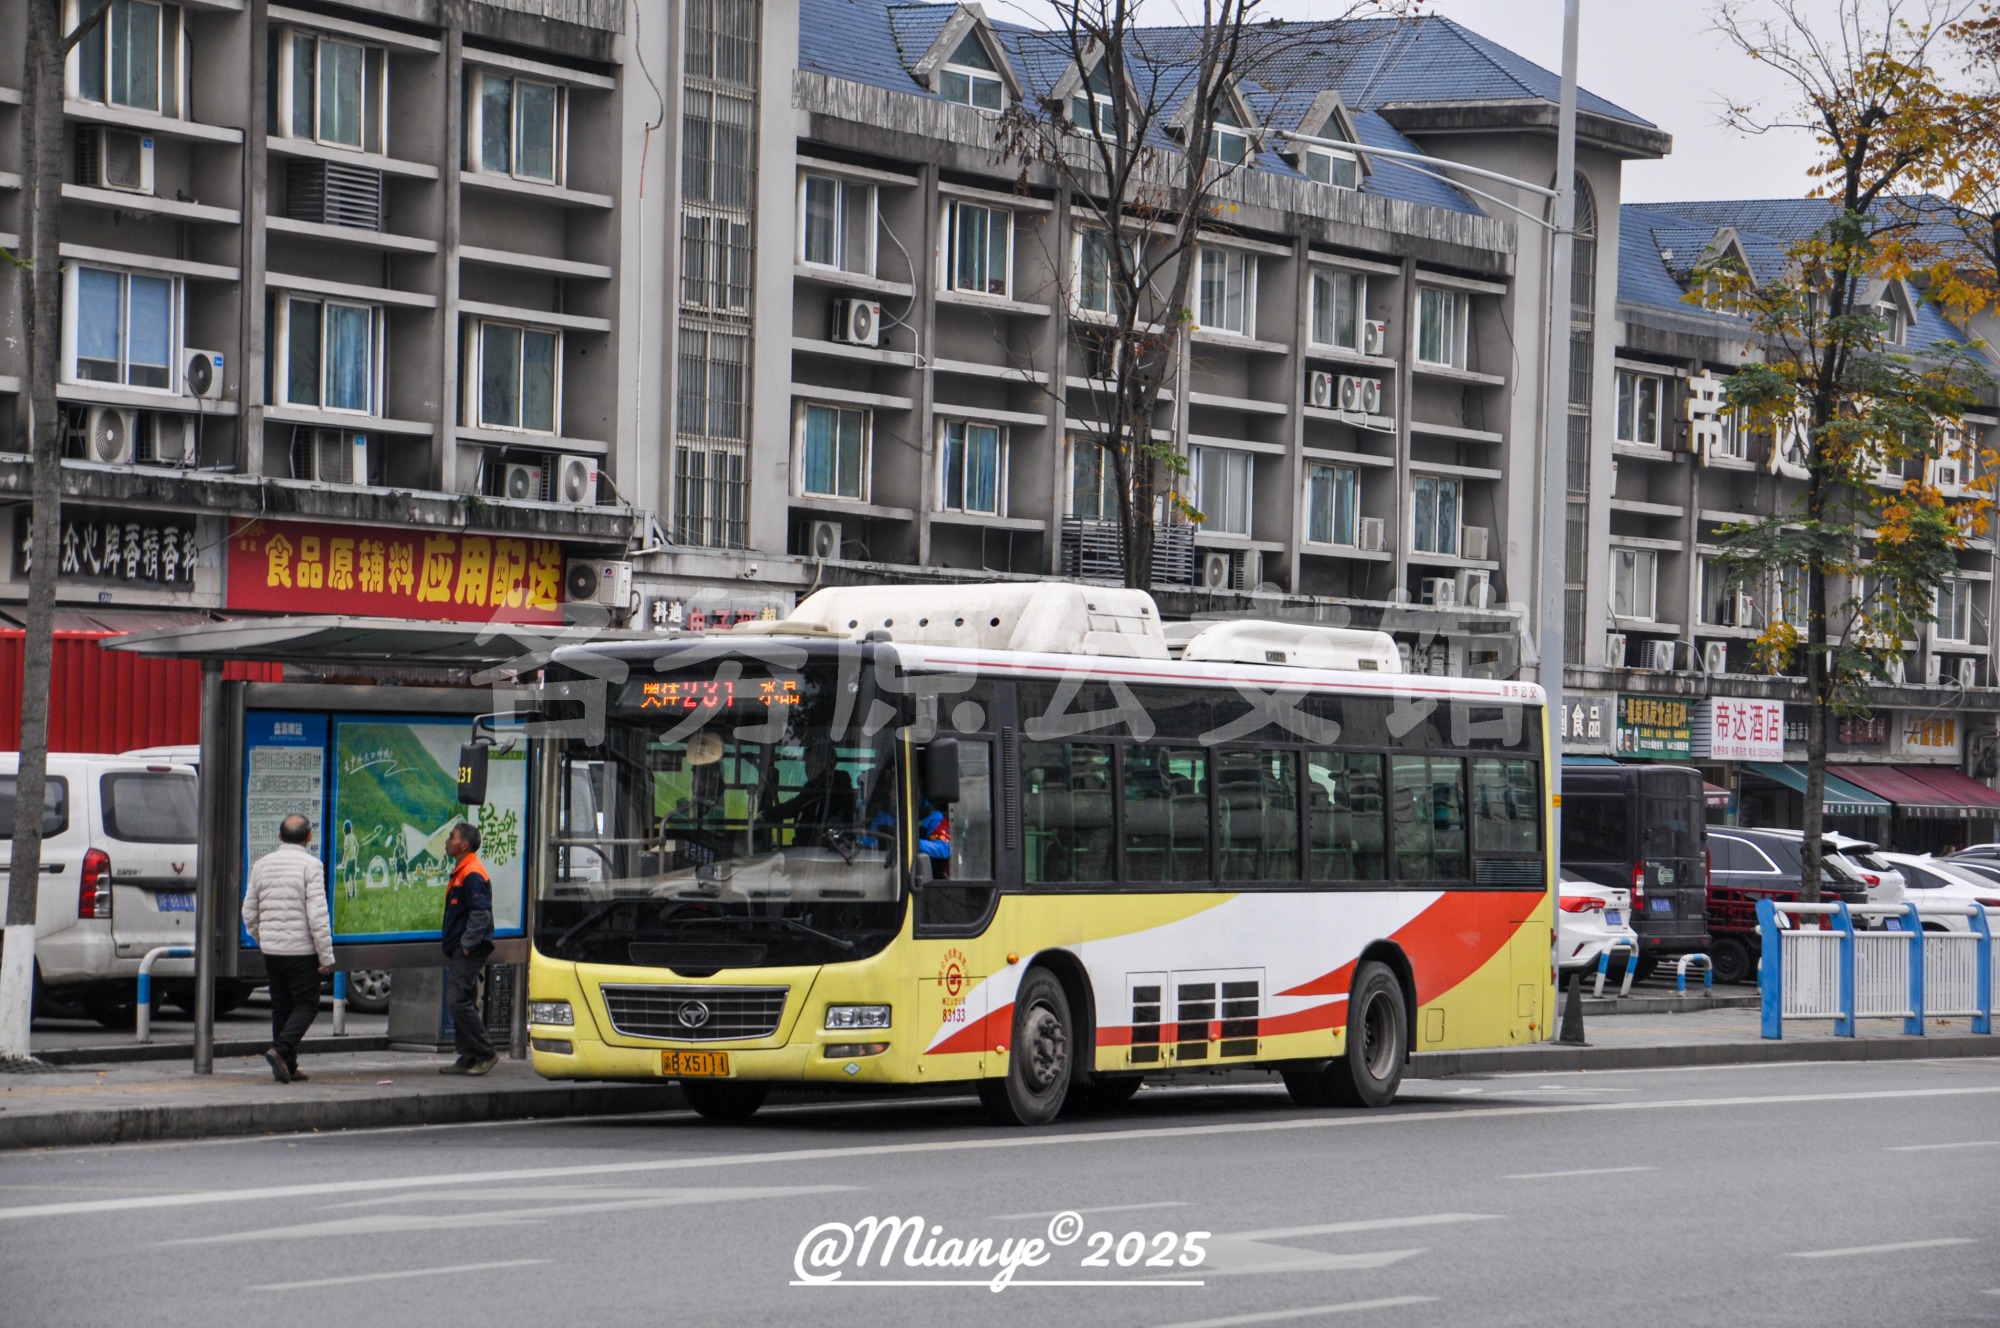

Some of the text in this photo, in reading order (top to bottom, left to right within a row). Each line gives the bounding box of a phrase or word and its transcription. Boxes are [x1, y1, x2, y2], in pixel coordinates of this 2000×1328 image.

[265, 533, 562, 612] 食品原辅料应用配送
[1503, 684, 1537, 699] 重庆公交
[1716, 701, 1780, 743] 帝达酒店
[942, 1008, 966, 1023] 83133
